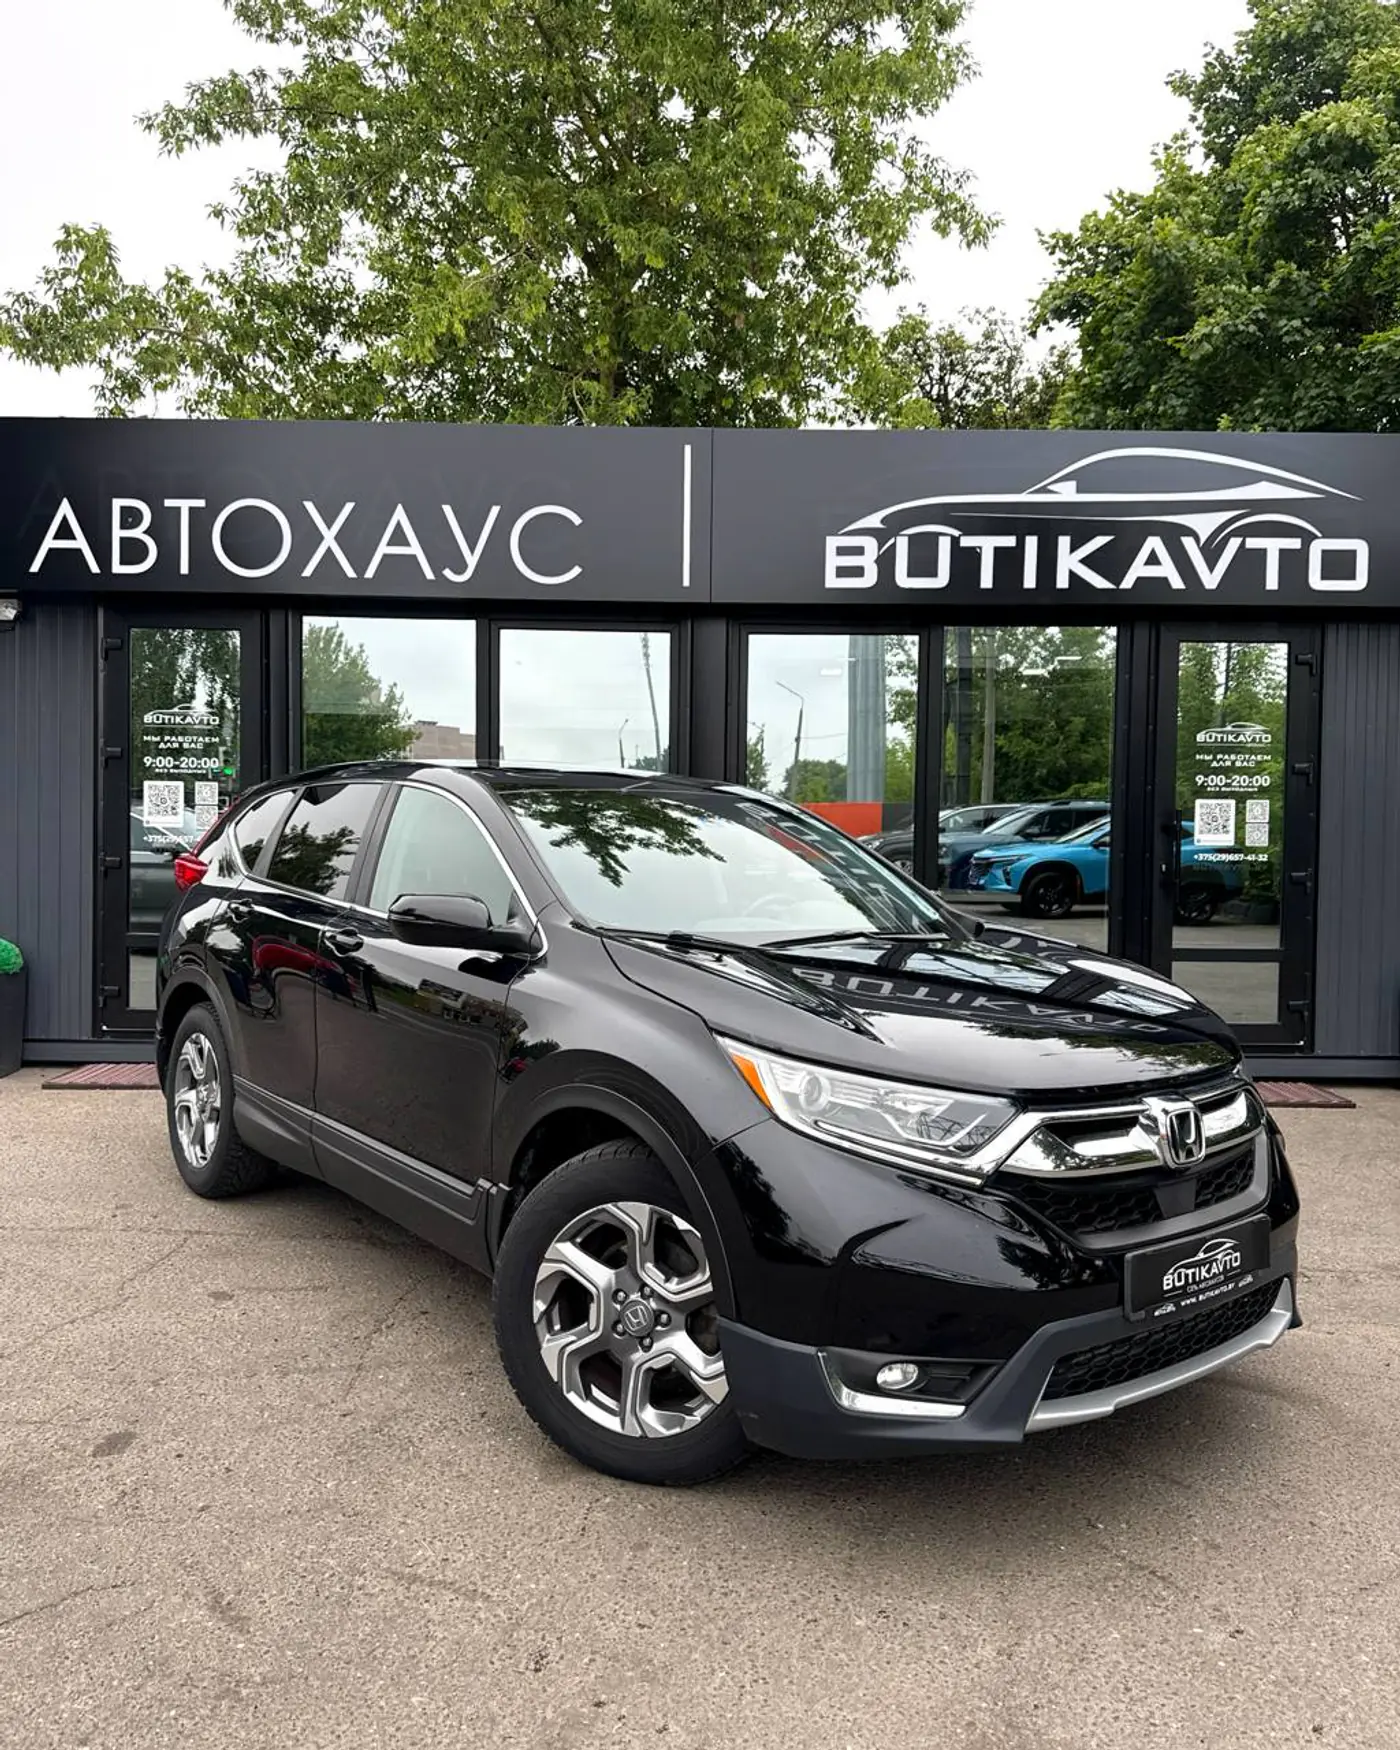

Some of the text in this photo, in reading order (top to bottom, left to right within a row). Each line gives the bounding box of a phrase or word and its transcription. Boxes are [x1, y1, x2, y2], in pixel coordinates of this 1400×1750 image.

[28, 497, 584, 585] АВТОХАУС
[824, 534, 1370, 592] BUTIKAVTO
[143, 713, 220, 725] BUTIKAVTO
[164, 735, 220, 743] РАБОТАЕМ
[1196, 732, 1272, 743] BUTIKAVTO
[143, 756, 219, 768] 9:00-20:00
[1216, 753, 1272, 761] РАБОТАЕМ
[1195, 775, 1271, 787] 9:00-20:00
[1163, 1252, 1241, 1290] BUTIKAVTO
